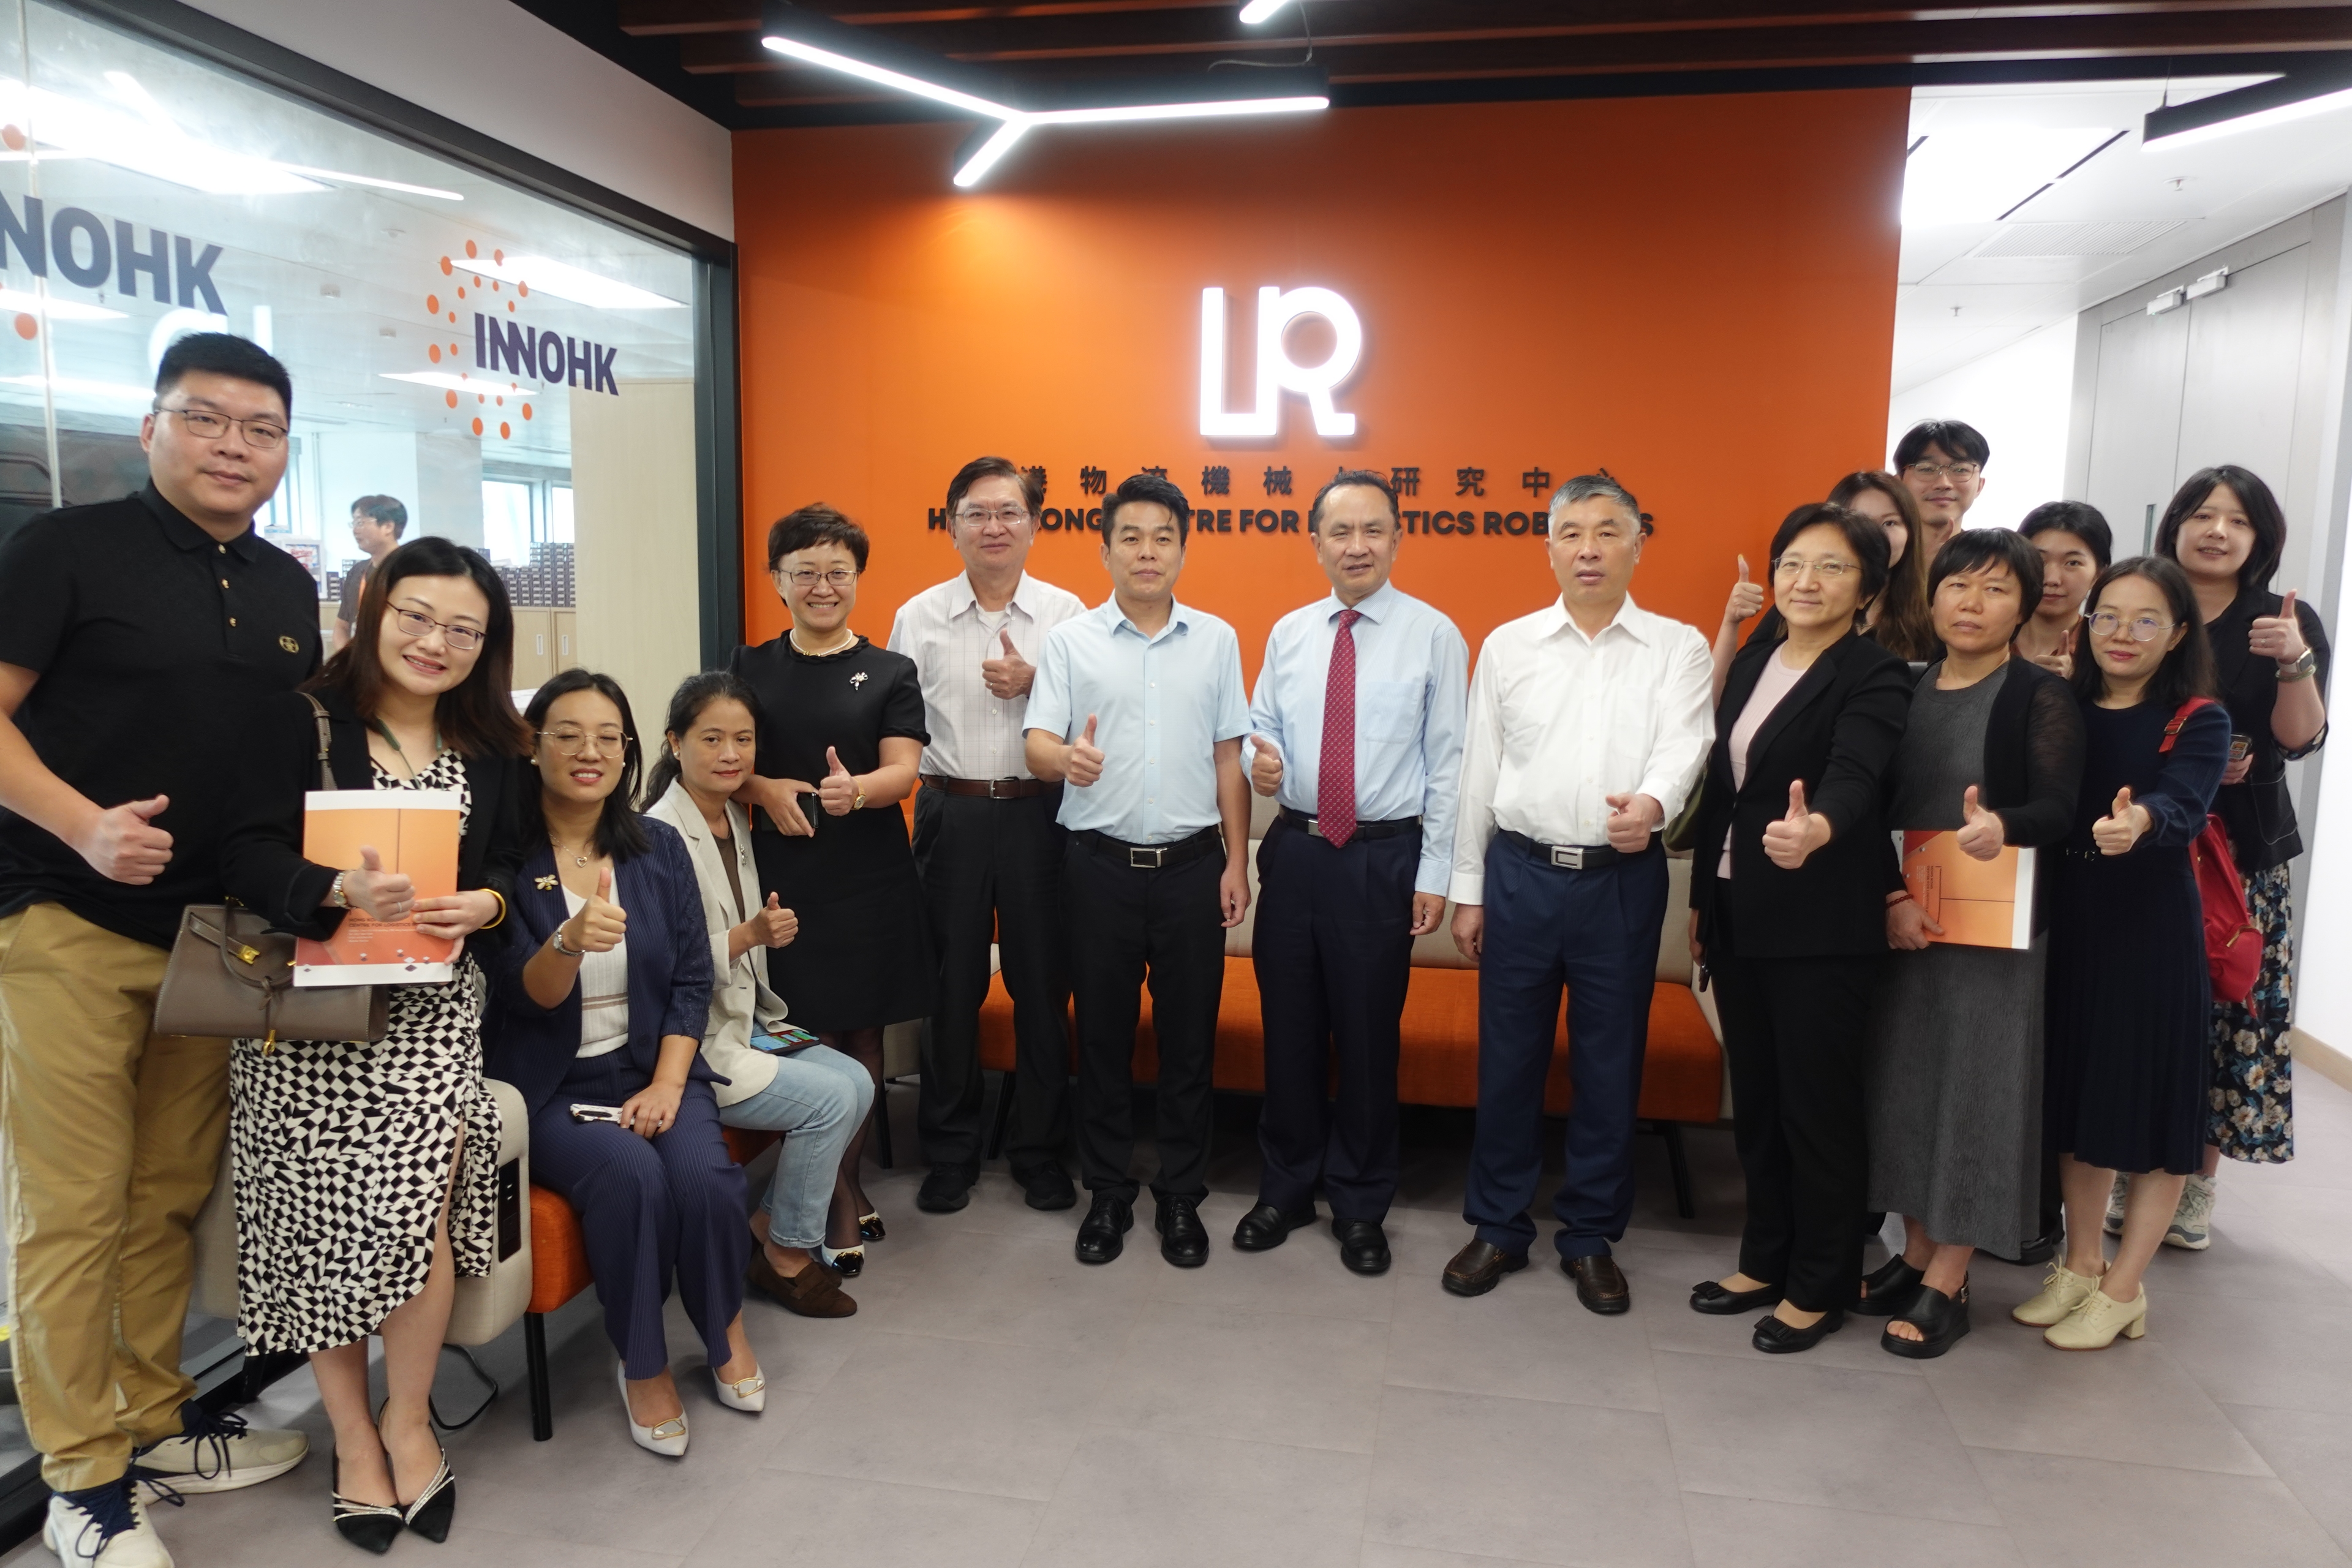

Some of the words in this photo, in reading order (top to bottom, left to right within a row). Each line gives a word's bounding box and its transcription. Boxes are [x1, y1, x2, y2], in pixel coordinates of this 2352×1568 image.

[0, 191, 228, 317] NOHK
[475, 312, 619, 396] INNOHK
[1039, 508, 1102, 531] ONG
[1240, 509, 1299, 533] FOR
